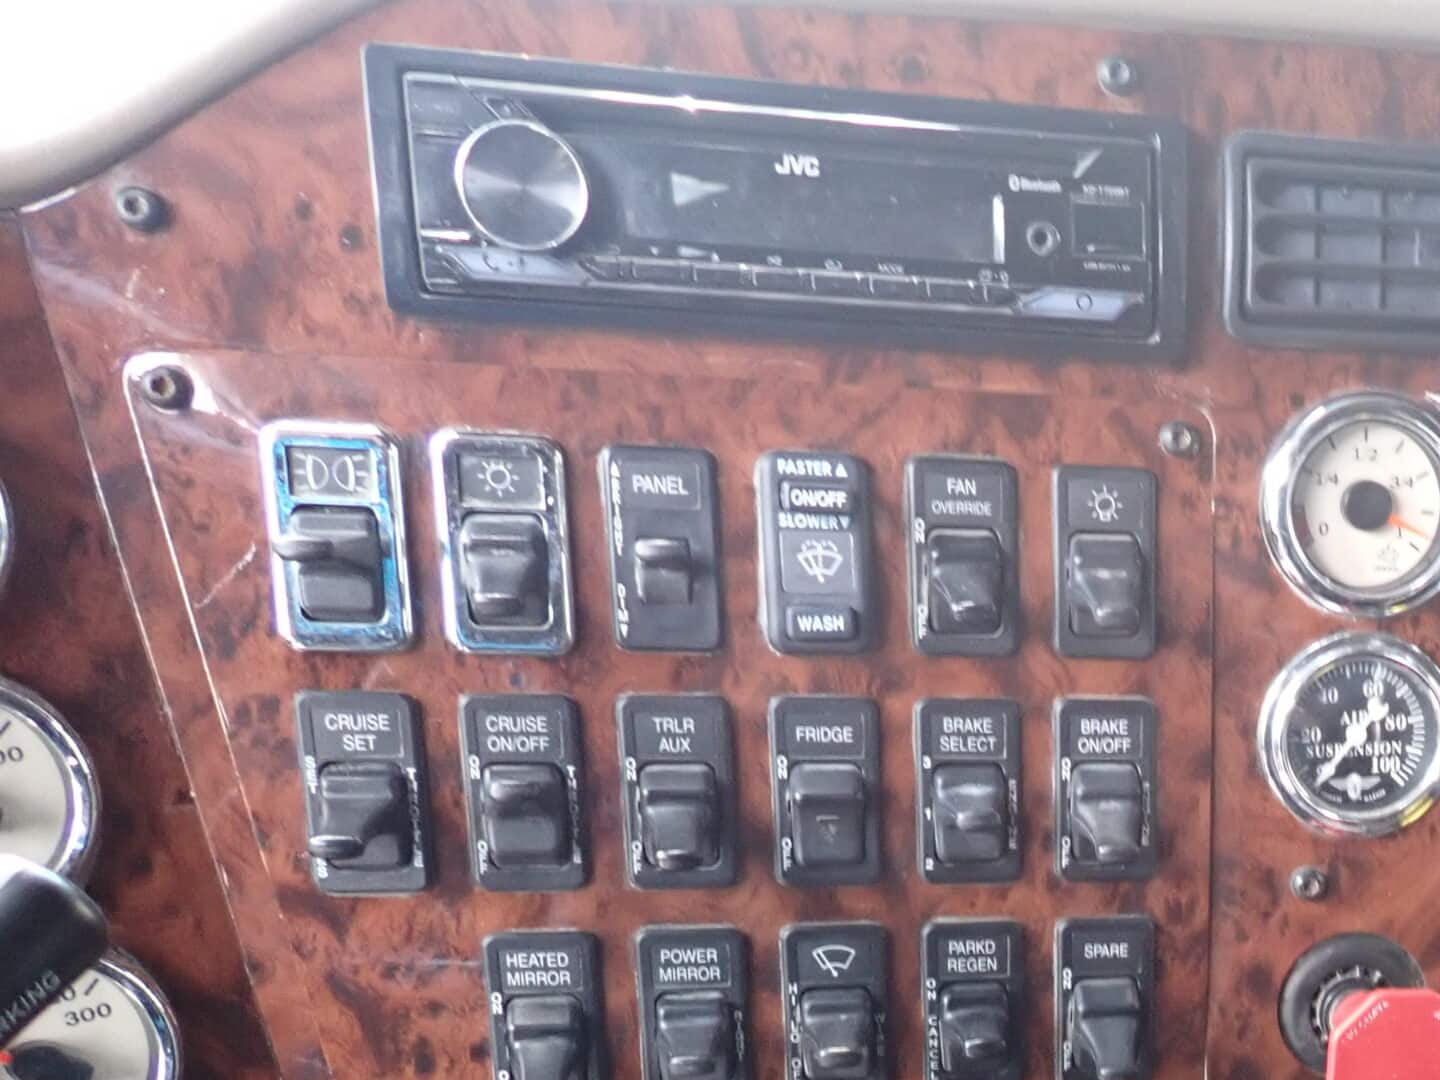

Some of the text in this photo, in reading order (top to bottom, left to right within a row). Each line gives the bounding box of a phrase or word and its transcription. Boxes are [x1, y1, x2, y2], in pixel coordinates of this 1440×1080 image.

[774, 153, 820, 177] JVC
[777, 458, 833, 477] FASTER
[632, 472, 688, 496] PANEL
[946, 478, 977, 496] FAN
[790, 489, 847, 508] ON/OFF
[931, 500, 992, 517] OVERRIDE
[777, 513, 838, 530] SLOWER
[915, 517, 926, 544] ON
[797, 615, 845, 633] WASH
[1321, 686, 1339, 704] 40
[1362, 679, 1384, 698] 60
[324, 713, 391, 731] CRUISE
[486, 716, 548, 733] CRUISE
[652, 717, 696, 734] TRLR
[943, 716, 993, 736] BRAKE
[1080, 718, 1129, 736] BRAKE
[1385, 713, 1407, 732] 80
[343, 734, 376, 751] SET
[796, 726, 854, 744] FRIDGE
[1301, 726, 1322, 744] 20
[487, 736, 550, 753] ON/OFF
[659, 737, 692, 753] AUX
[939, 736, 998, 753] SELECT
[1077, 738, 1132, 754] ON/OFF
[469, 754, 481, 780] ON
[626, 756, 637, 782] ON
[777, 754, 788, 780] ON
[1061, 757, 1072, 781] ON
[1371, 755, 1401, 775] 100
[925, 857, 934, 871] 2
[948, 939, 996, 955] PARKD
[1084, 943, 1129, 959] SPARE
[505, 951, 569, 970] HEATED
[660, 948, 718, 965] POWER
[947, 957, 998, 972] REGEN
[506, 971, 571, 987] MIRROR
[659, 966, 721, 982] MIRROR
[1063, 967, 1073, 990] ON
[926, 977, 937, 1001] ON
[491, 992, 503, 1015] ON
[65, 1002, 112, 1026] 300
